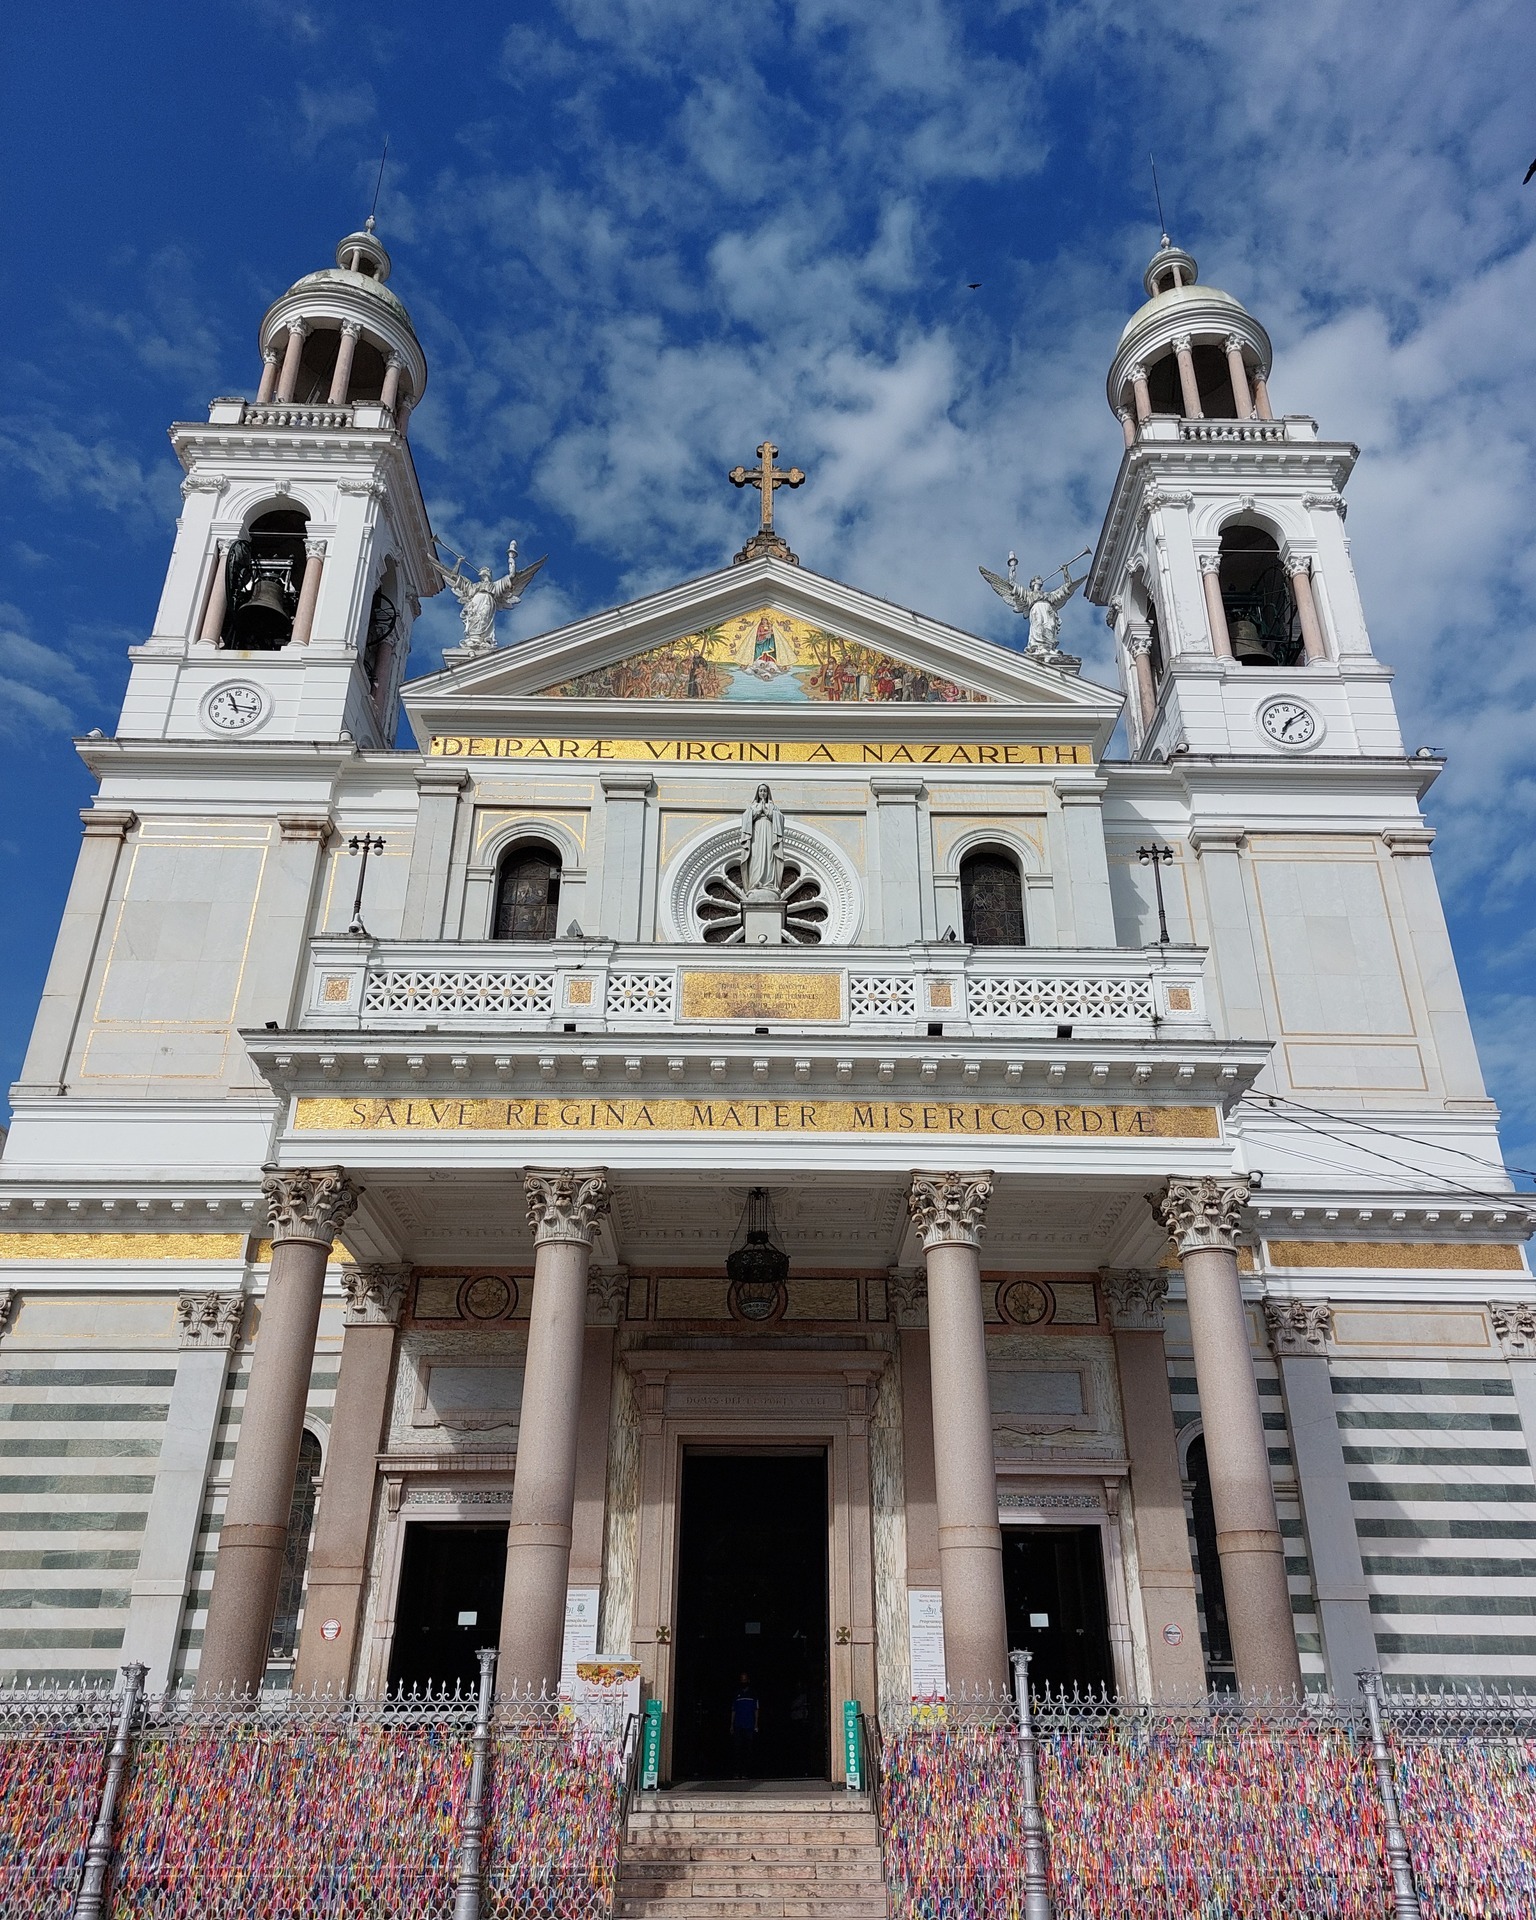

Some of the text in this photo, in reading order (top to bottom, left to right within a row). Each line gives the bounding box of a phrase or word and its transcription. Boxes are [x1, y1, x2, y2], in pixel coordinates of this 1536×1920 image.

[442, 738, 1079, 764] DEIPARÆ VIRGINI A NAZARETH
[350, 1103, 1155, 1133] SALVE REGINA MATER MISERICORDIÆ
